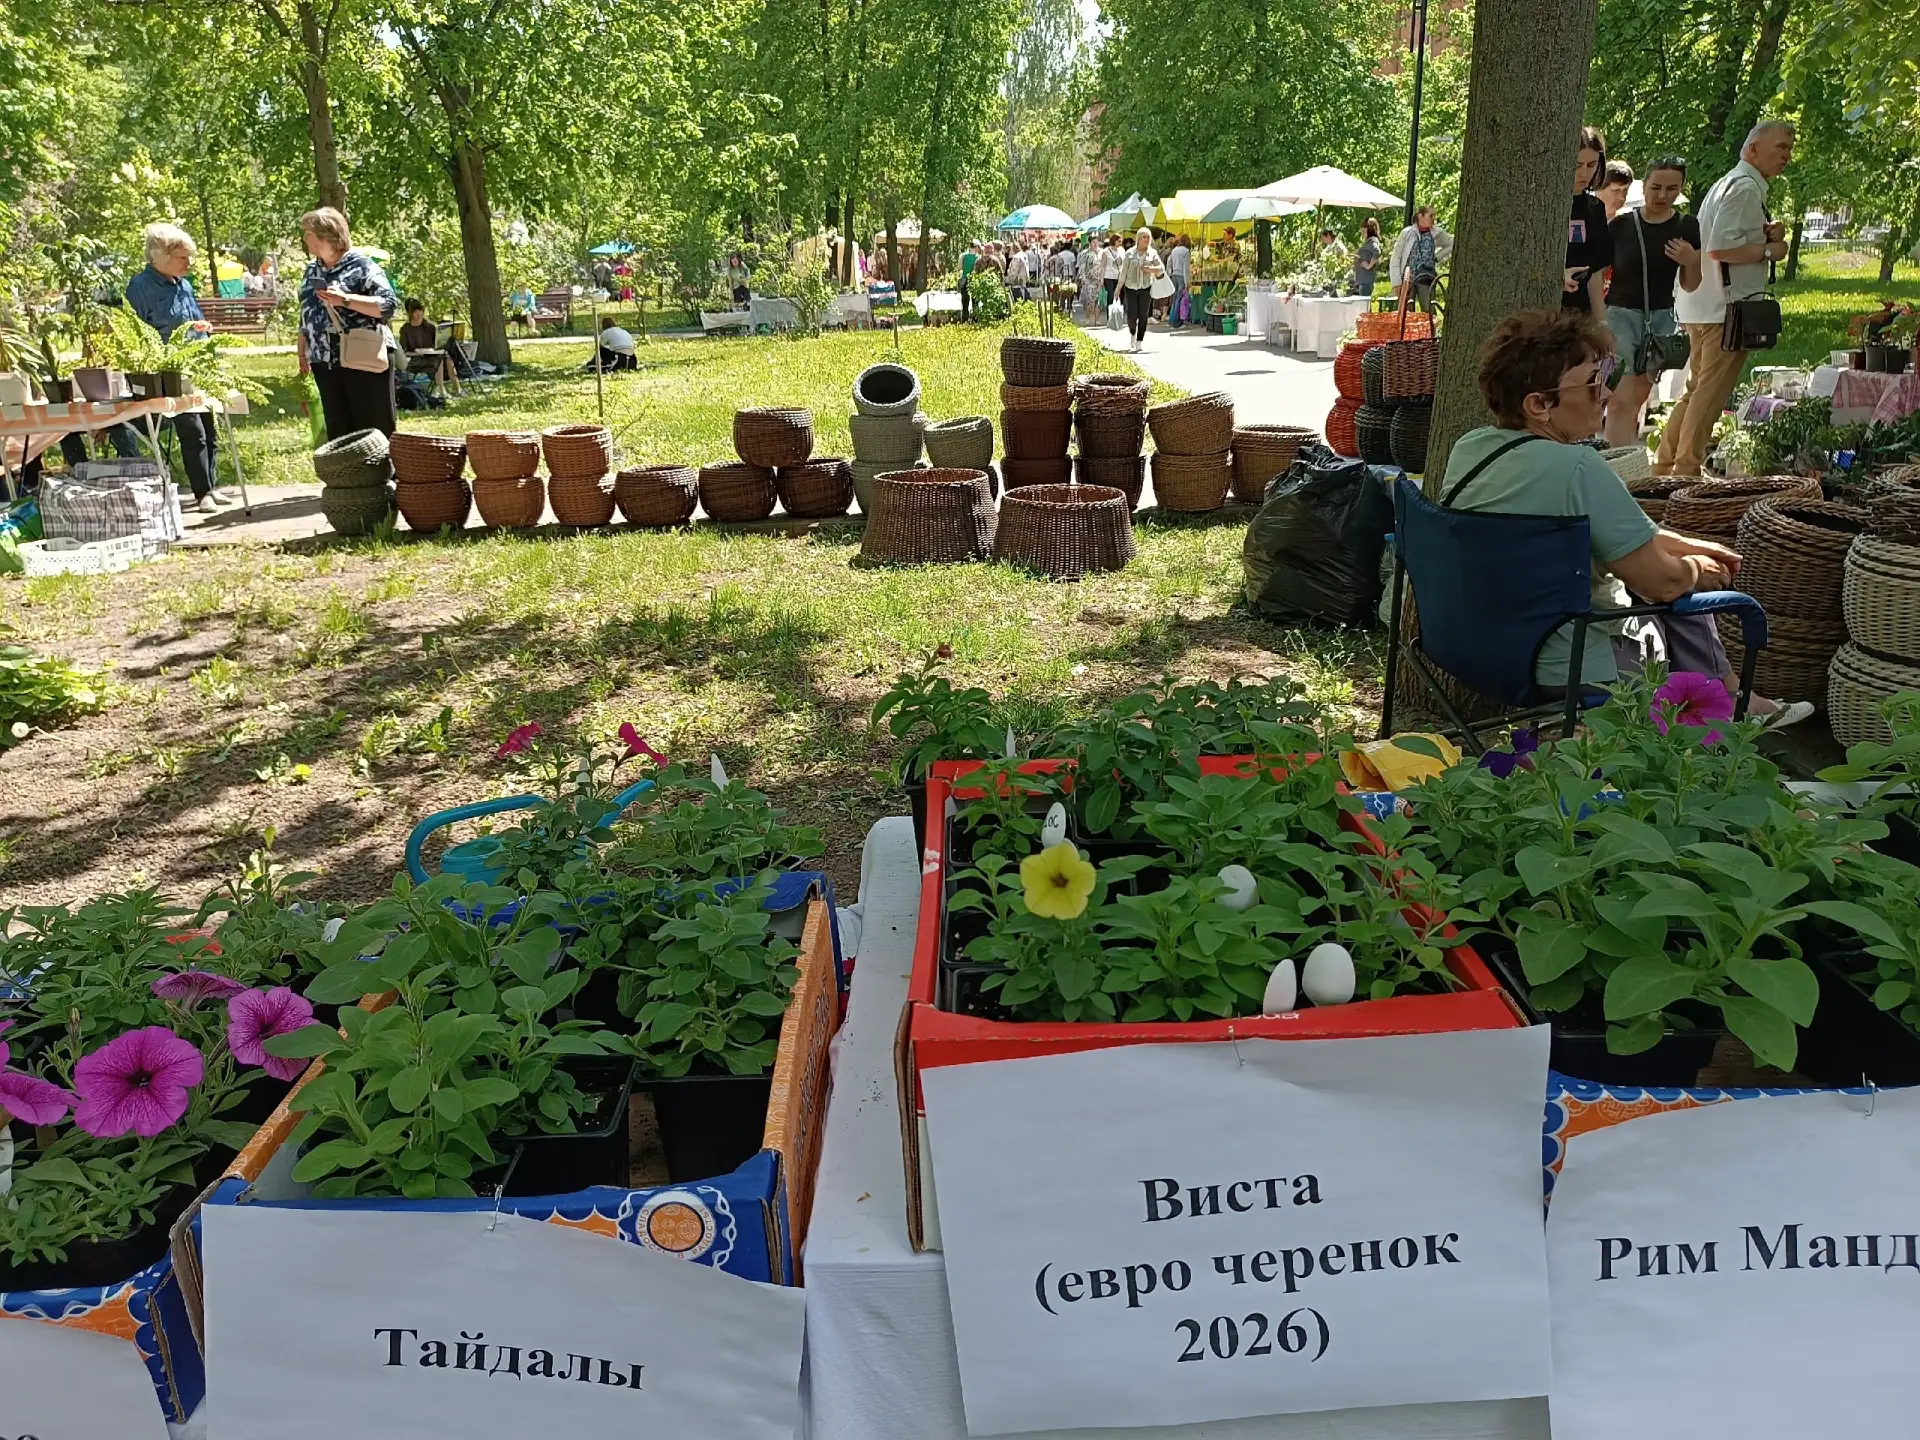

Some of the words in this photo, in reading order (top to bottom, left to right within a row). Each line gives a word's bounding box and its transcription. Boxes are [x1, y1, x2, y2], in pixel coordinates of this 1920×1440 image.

[1137, 1174, 1324, 1223] Виста
[1035, 1259, 1192, 1316] (евро
[1211, 1232, 1462, 1294] черенок
[1594, 1237, 1719, 1282] Рим
[1739, 1223, 1920, 1275] Манд
[373, 1328, 645, 1391] Тайдалы
[1174, 1307, 1330, 1363] 2026)
